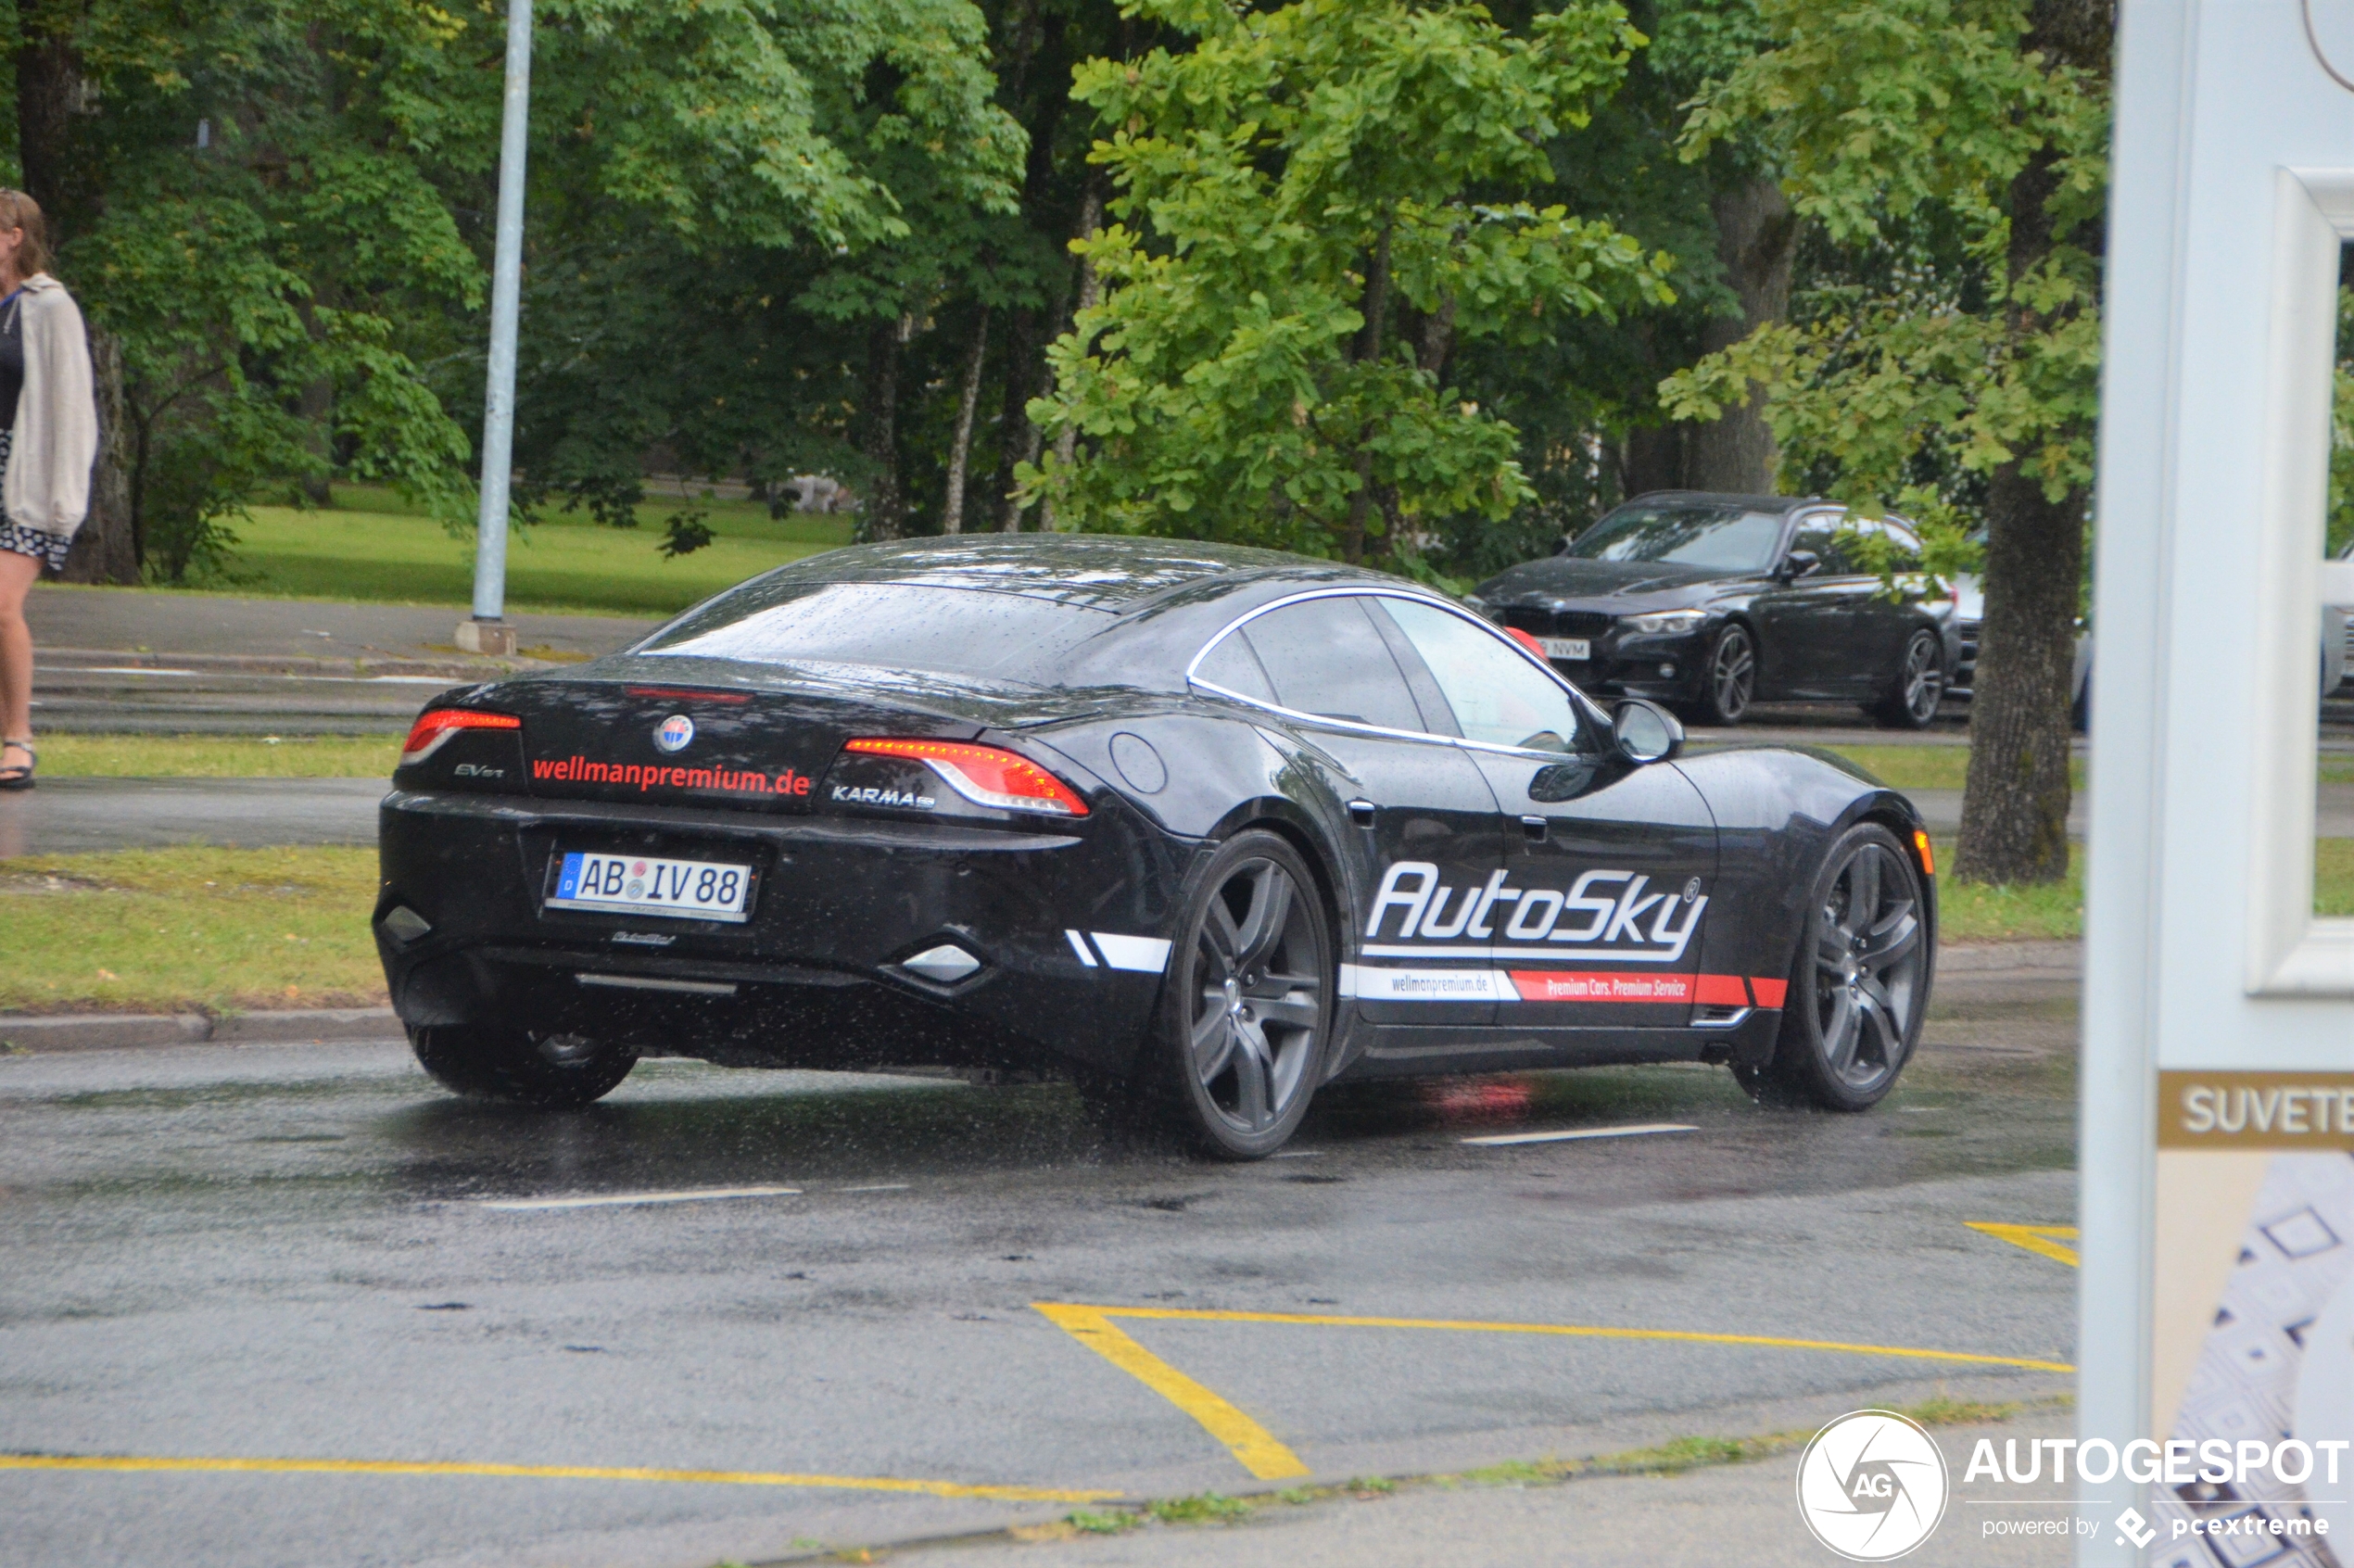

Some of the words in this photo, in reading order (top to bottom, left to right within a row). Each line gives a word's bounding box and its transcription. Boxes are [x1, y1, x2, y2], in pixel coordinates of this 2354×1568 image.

[532, 755, 811, 795] wellmanpremium.de
[831, 785, 915, 807] KARMA
[563, 879, 574, 891] D
[580, 858, 626, 896] AB
[647, 864, 692, 901] IV
[695, 867, 740, 904] 88
[1391, 974, 1488, 996] wellmanpremium.de
[1547, 977, 1588, 995] Premium
[1589, 978, 1612, 995] Cars.
[1613, 978, 1652, 996] Premium
[1653, 979, 1687, 996] Service
